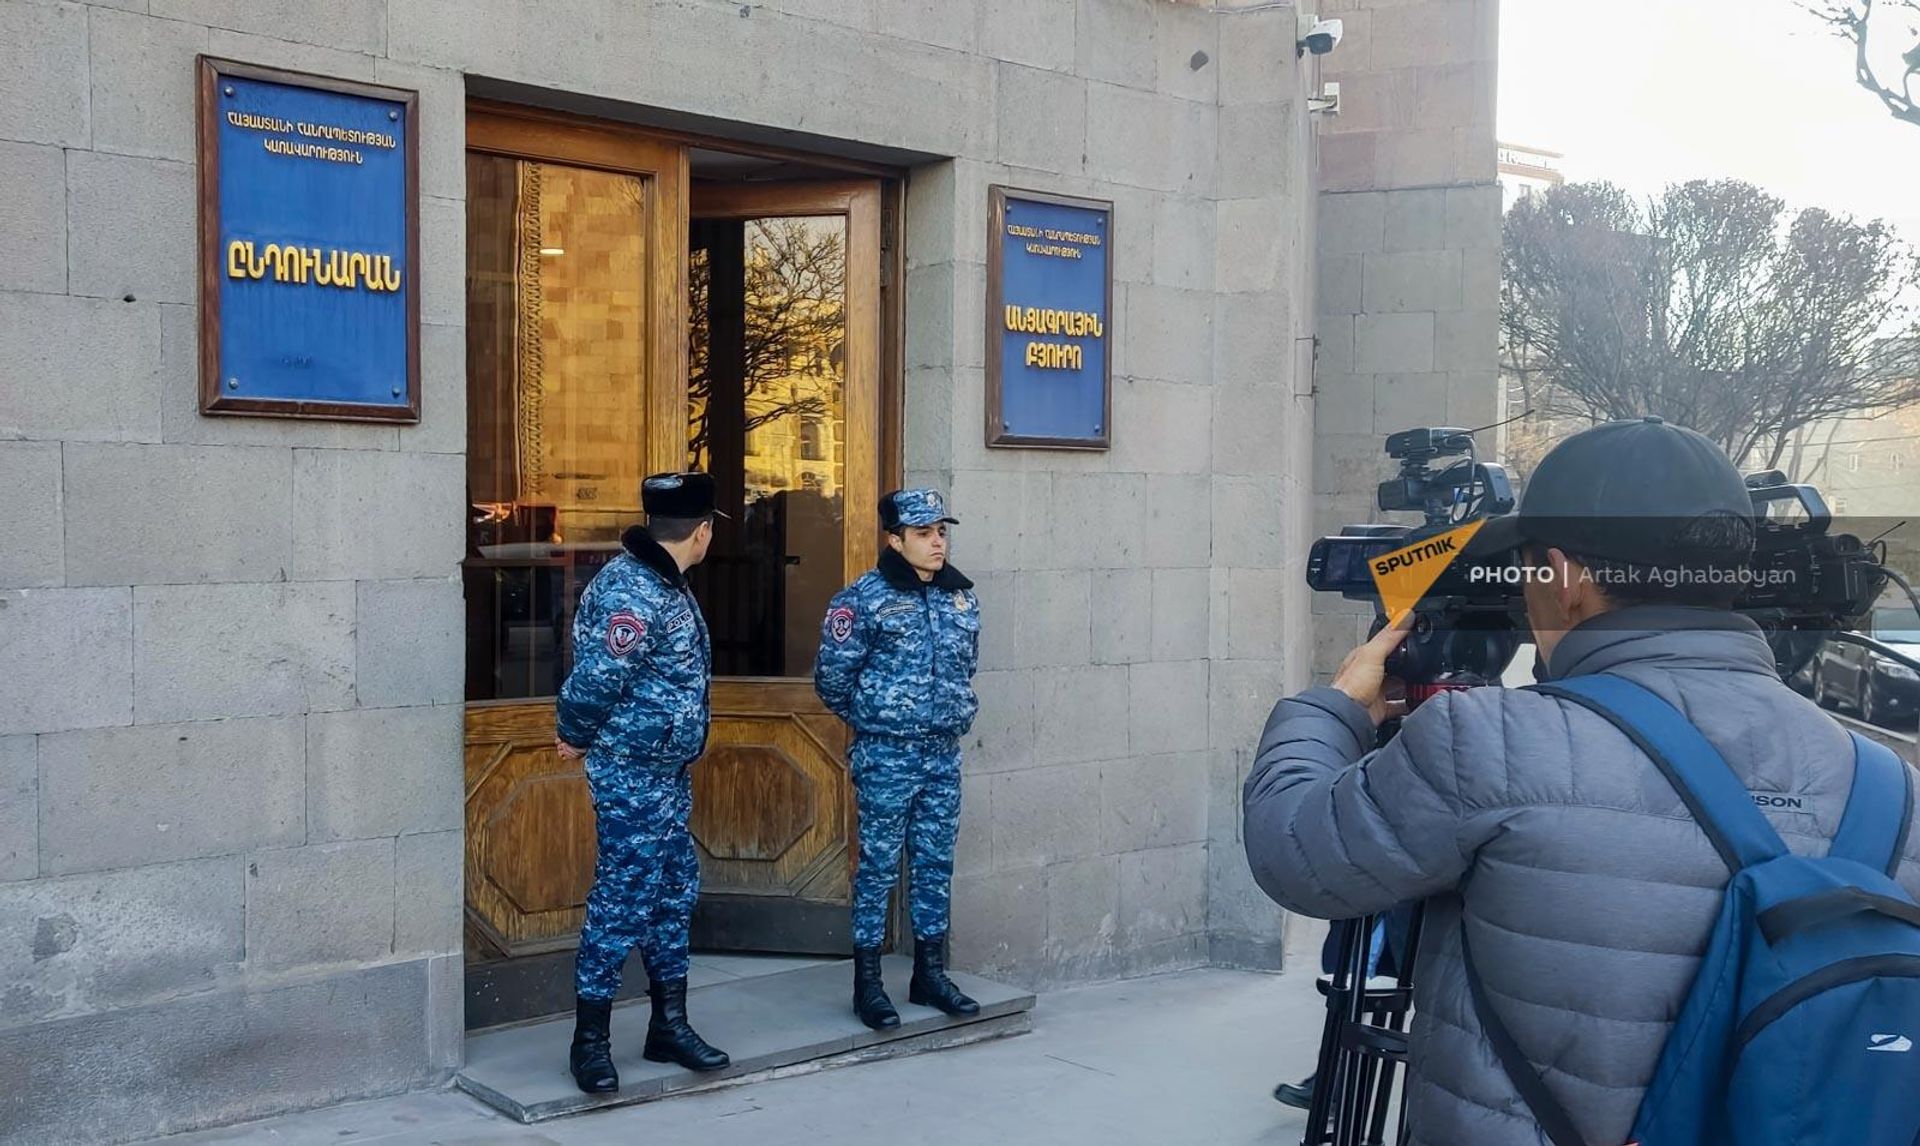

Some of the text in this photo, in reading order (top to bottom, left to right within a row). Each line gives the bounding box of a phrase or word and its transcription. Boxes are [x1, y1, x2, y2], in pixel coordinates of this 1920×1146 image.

[227, 111, 397, 149] ՀԱՅԱՍՏԱՆԻ ՀԱՆՐԱՊԵՏՈՒԹՅԱՆ
[263, 138, 364, 164] ԿԱՌԱՎԱՐՈՒԹՅՈՒՆ
[228, 240, 400, 292] ԸՆԴՈՒՆԱՐԱՆ
[1005, 304, 1103, 338] ԱՆՑԱԳՐԱՅԻՆ
[1026, 341, 1082, 370] ԲՅՈՒՐՈ
[1751, 795, 1802, 808] SON
